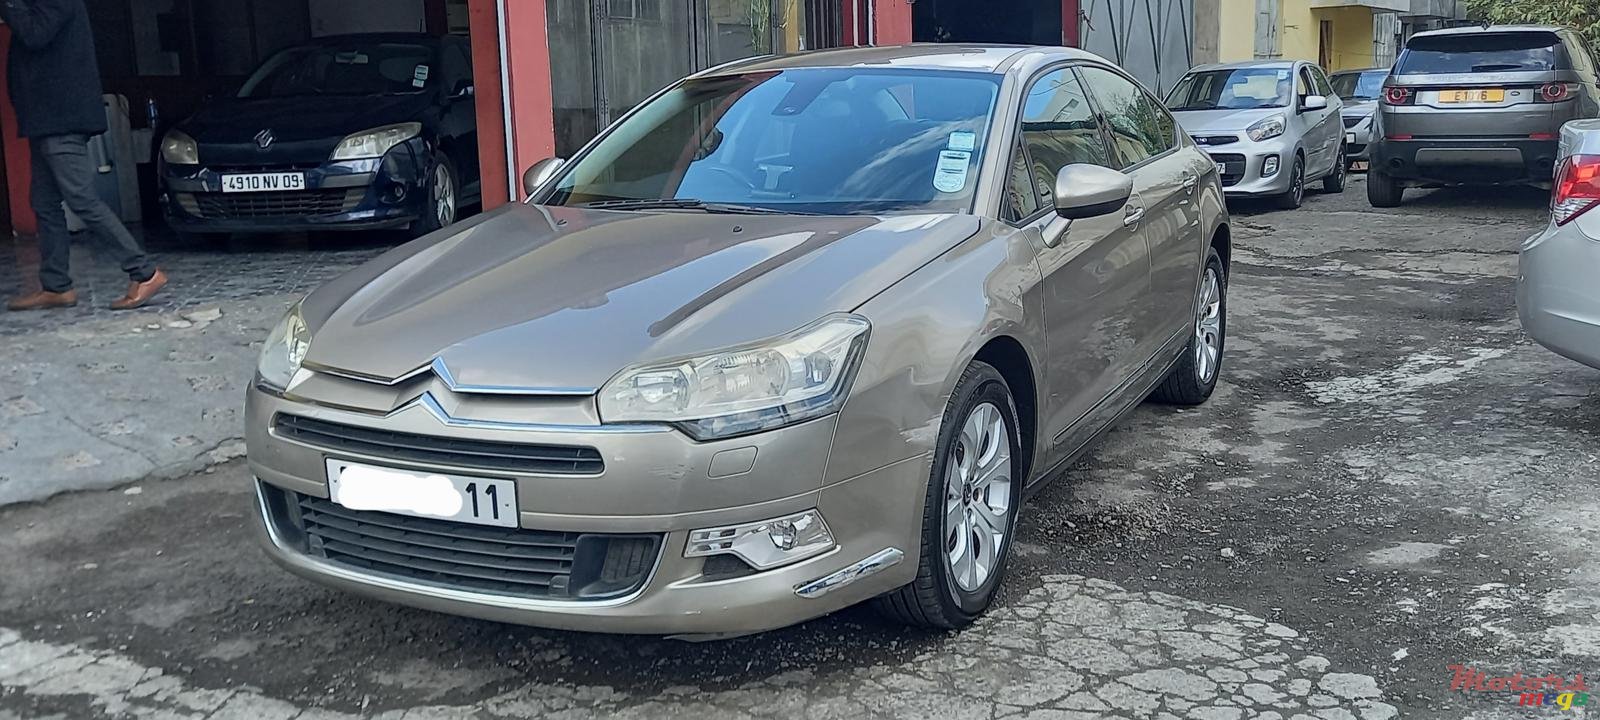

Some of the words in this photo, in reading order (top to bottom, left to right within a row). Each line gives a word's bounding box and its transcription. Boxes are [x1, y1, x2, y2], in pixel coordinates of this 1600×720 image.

[229, 176, 260, 190] 4910
[263, 175, 279, 189] NV
[283, 174, 300, 188] 09
[465, 482, 499, 520] 11
